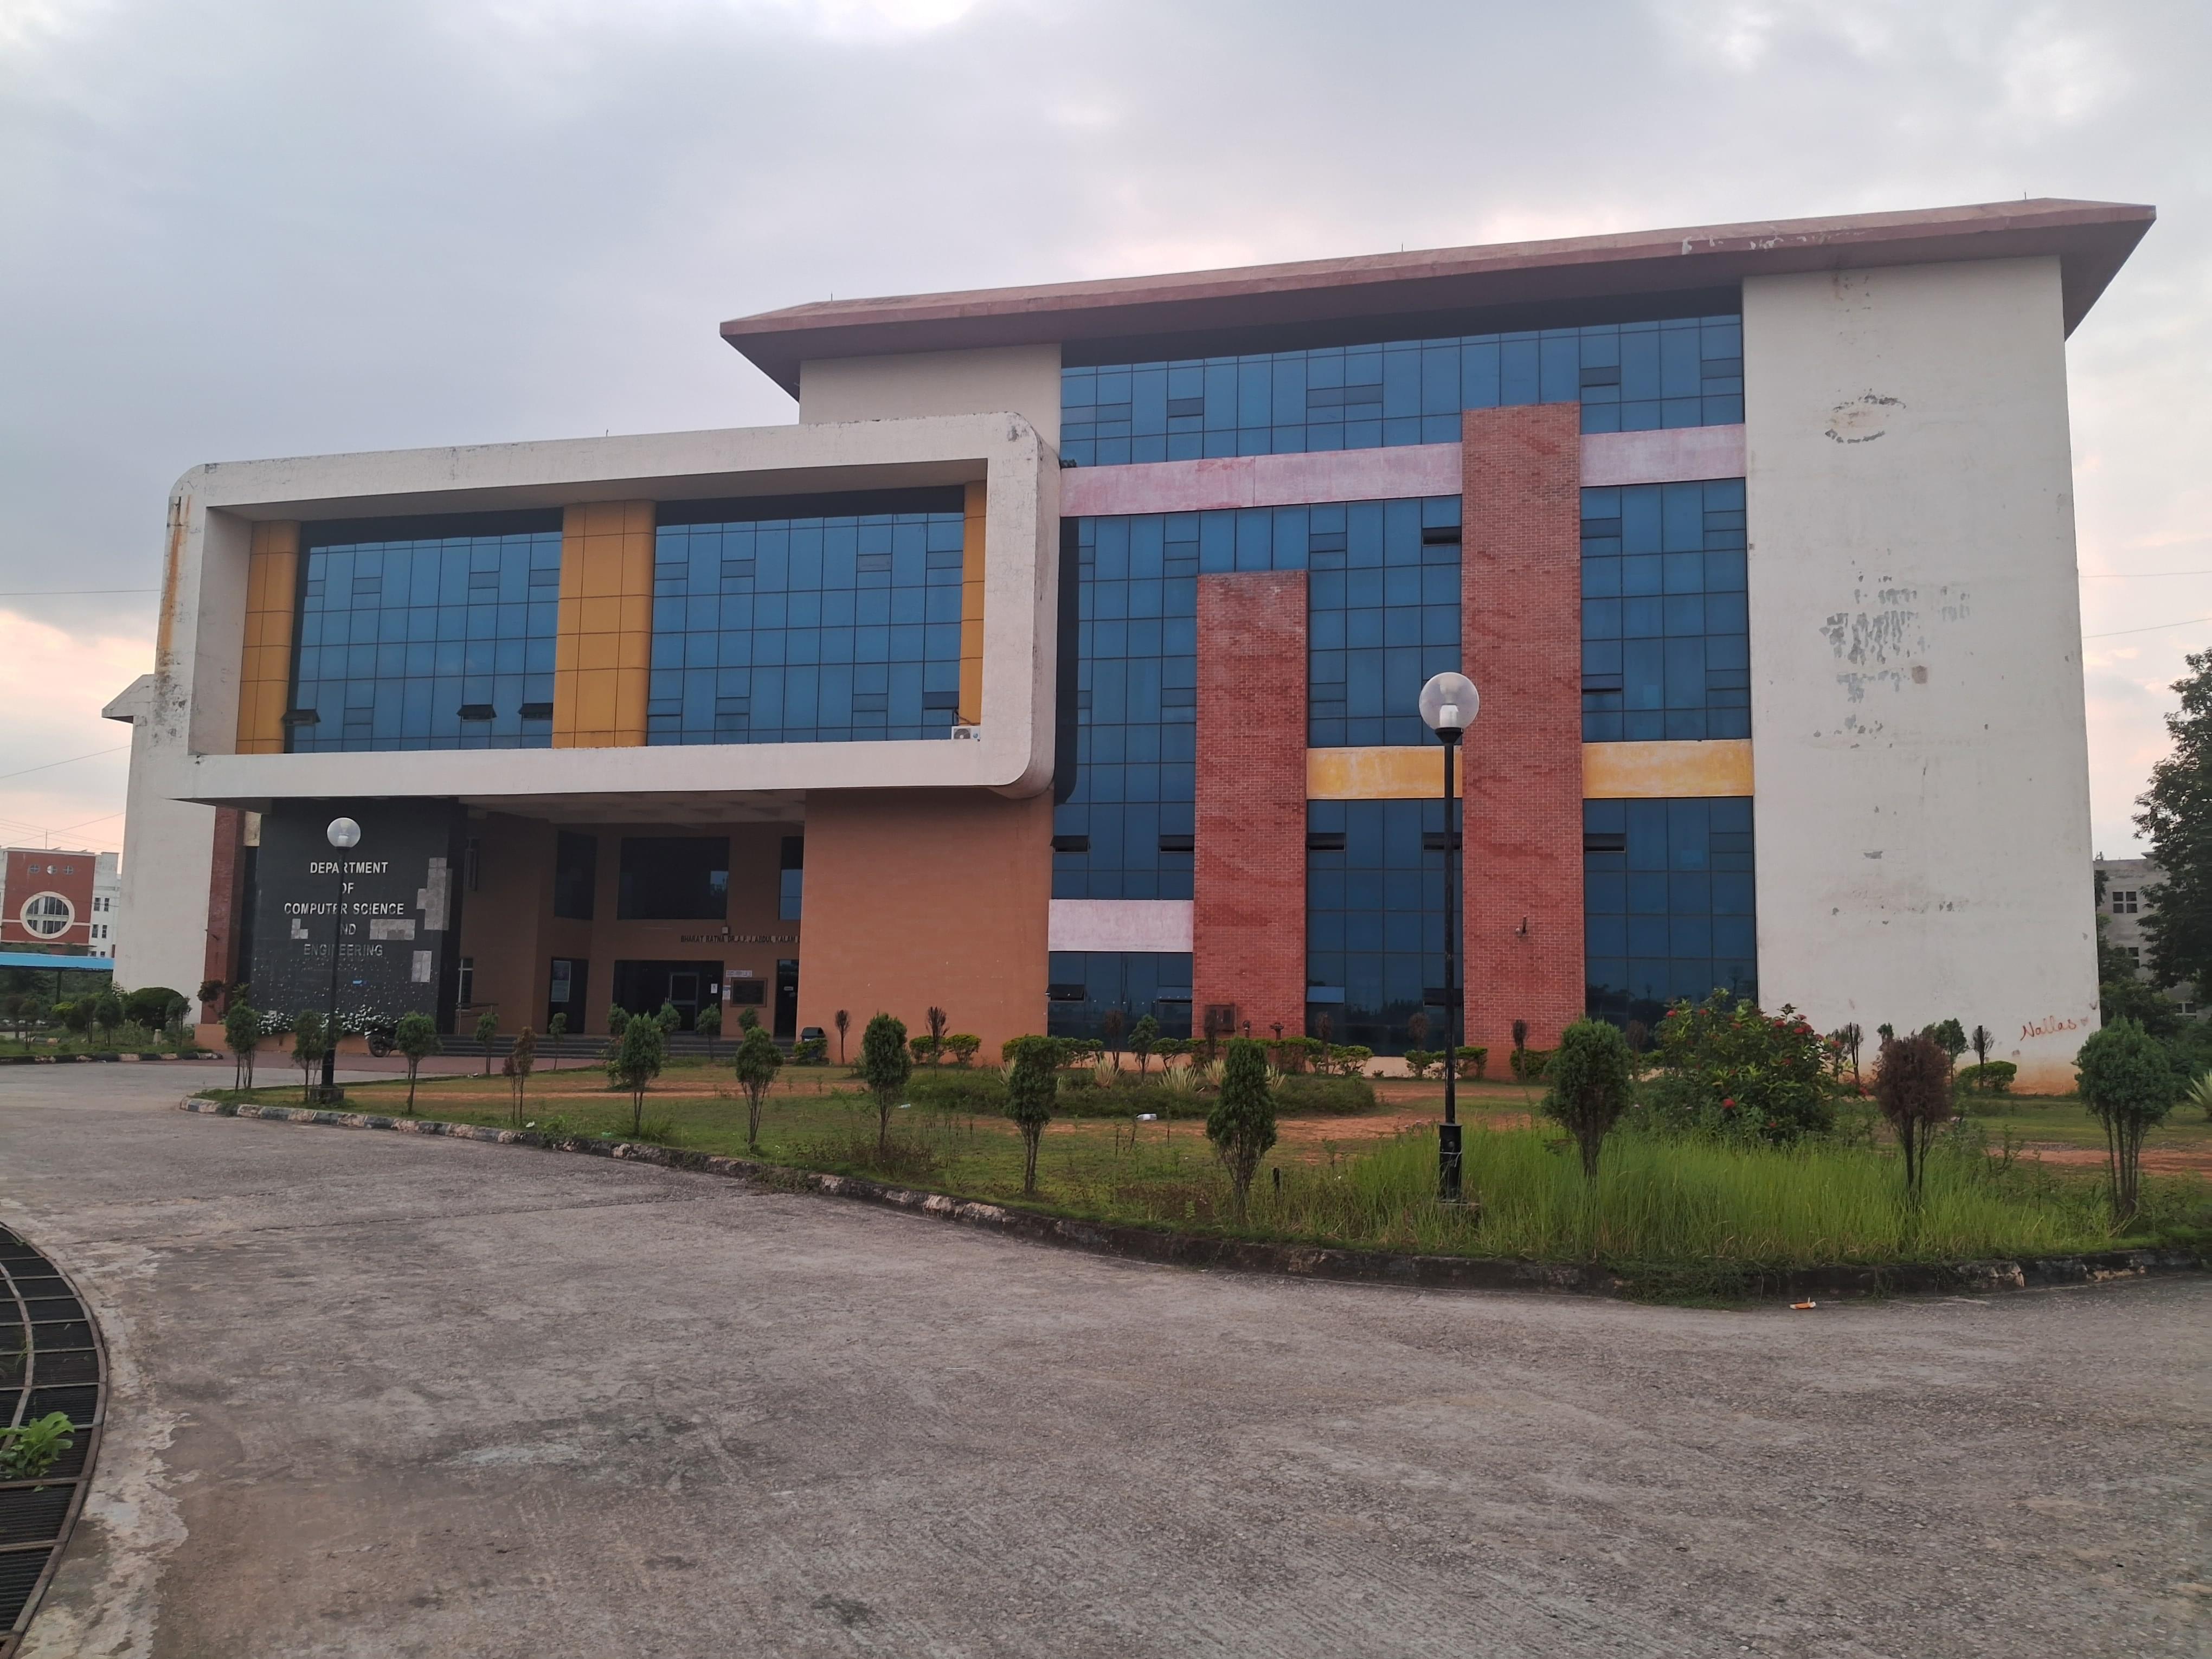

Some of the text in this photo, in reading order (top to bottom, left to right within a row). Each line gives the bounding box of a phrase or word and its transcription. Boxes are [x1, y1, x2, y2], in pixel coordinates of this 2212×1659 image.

[310, 861, 388, 873] DEPARTMENT
[284, 903, 404, 915] COMPUTER SCIENCE
